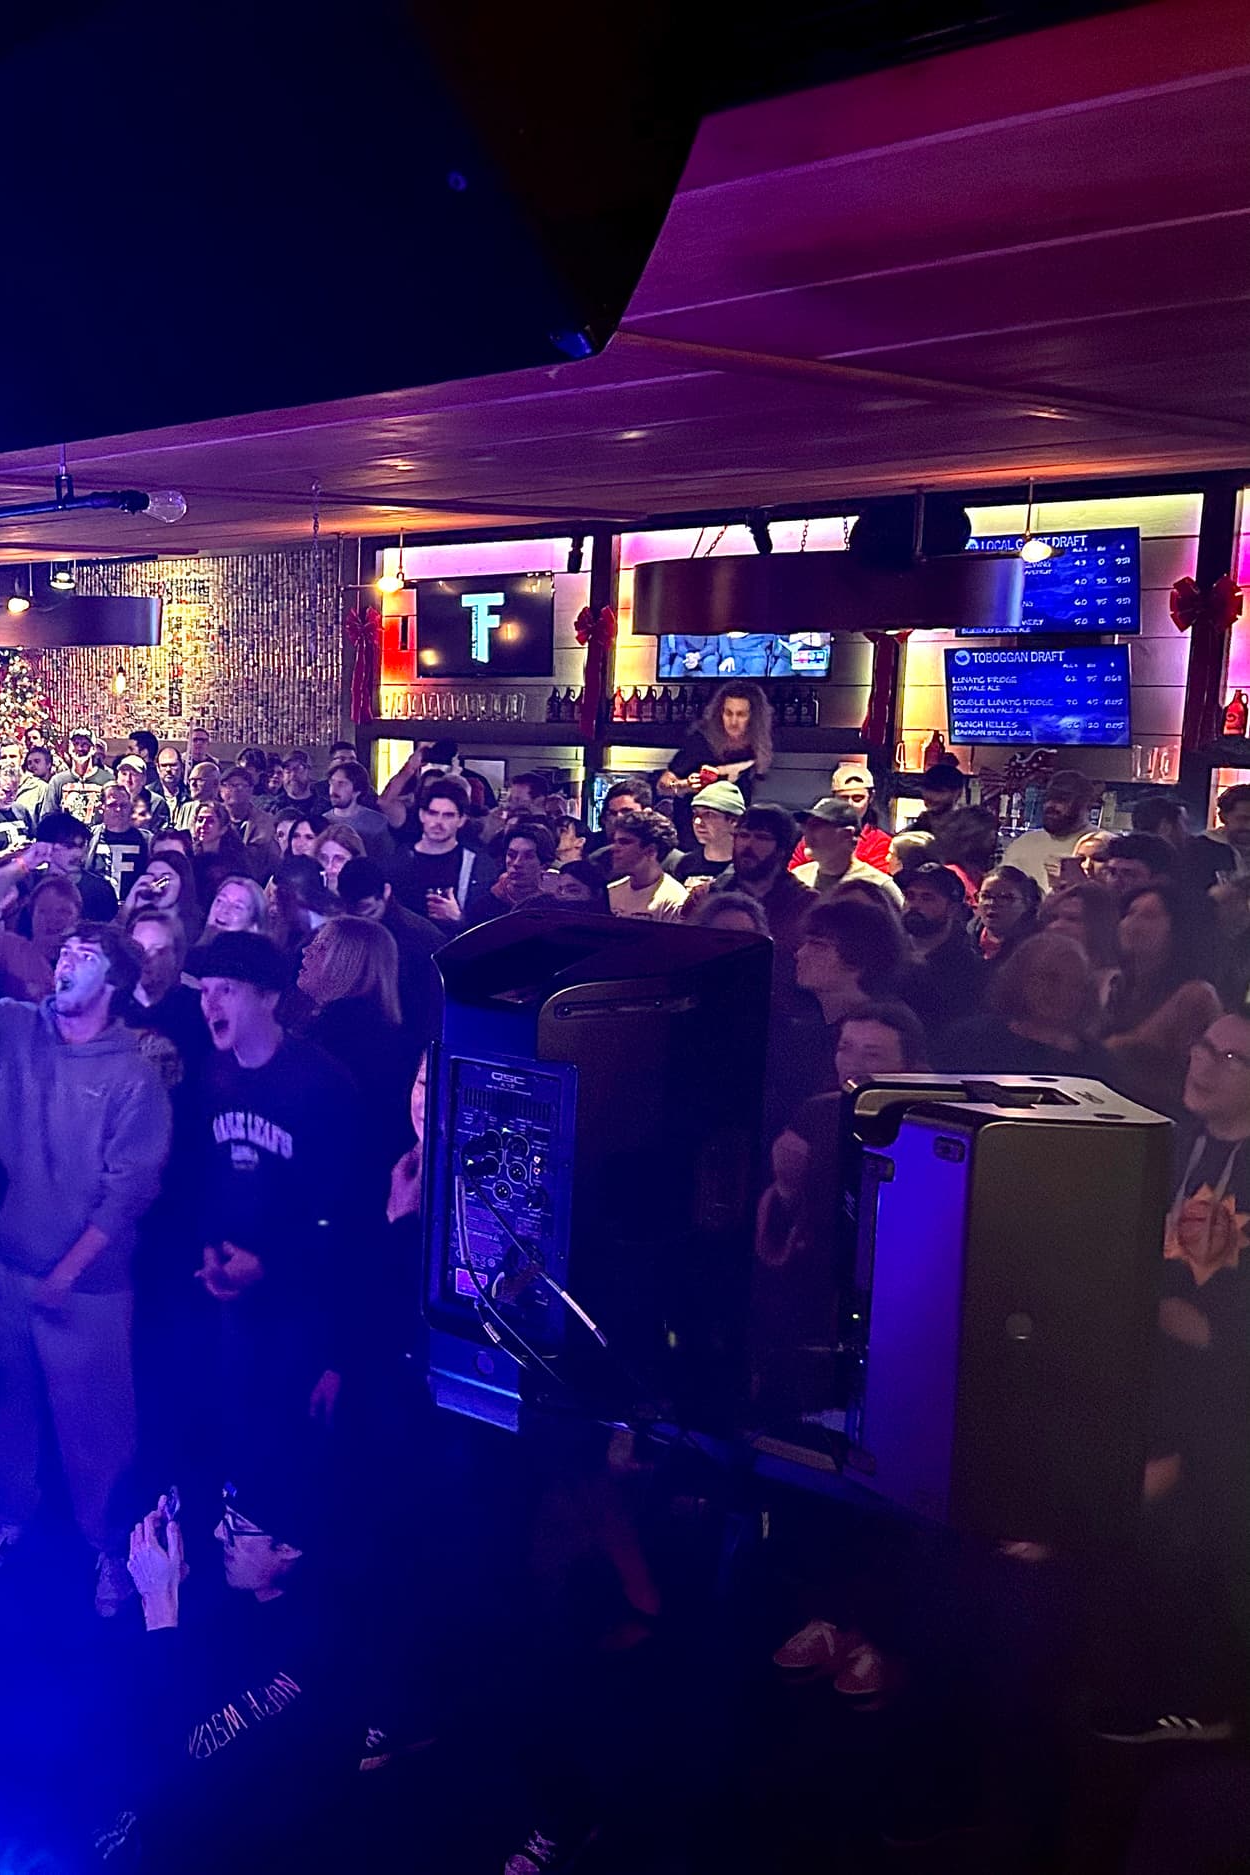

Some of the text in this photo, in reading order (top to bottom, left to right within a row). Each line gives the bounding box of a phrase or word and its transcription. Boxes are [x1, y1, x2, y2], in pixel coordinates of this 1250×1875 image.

[1052, 535, 1088, 547] DRAFT
[972, 650, 1065, 664] TOBOGGAN DRAFT
[953, 698, 985, 706] DOUBLE
[987, 698, 1021, 706] LUNATIC
[491, 1072, 526, 1085] QSC
